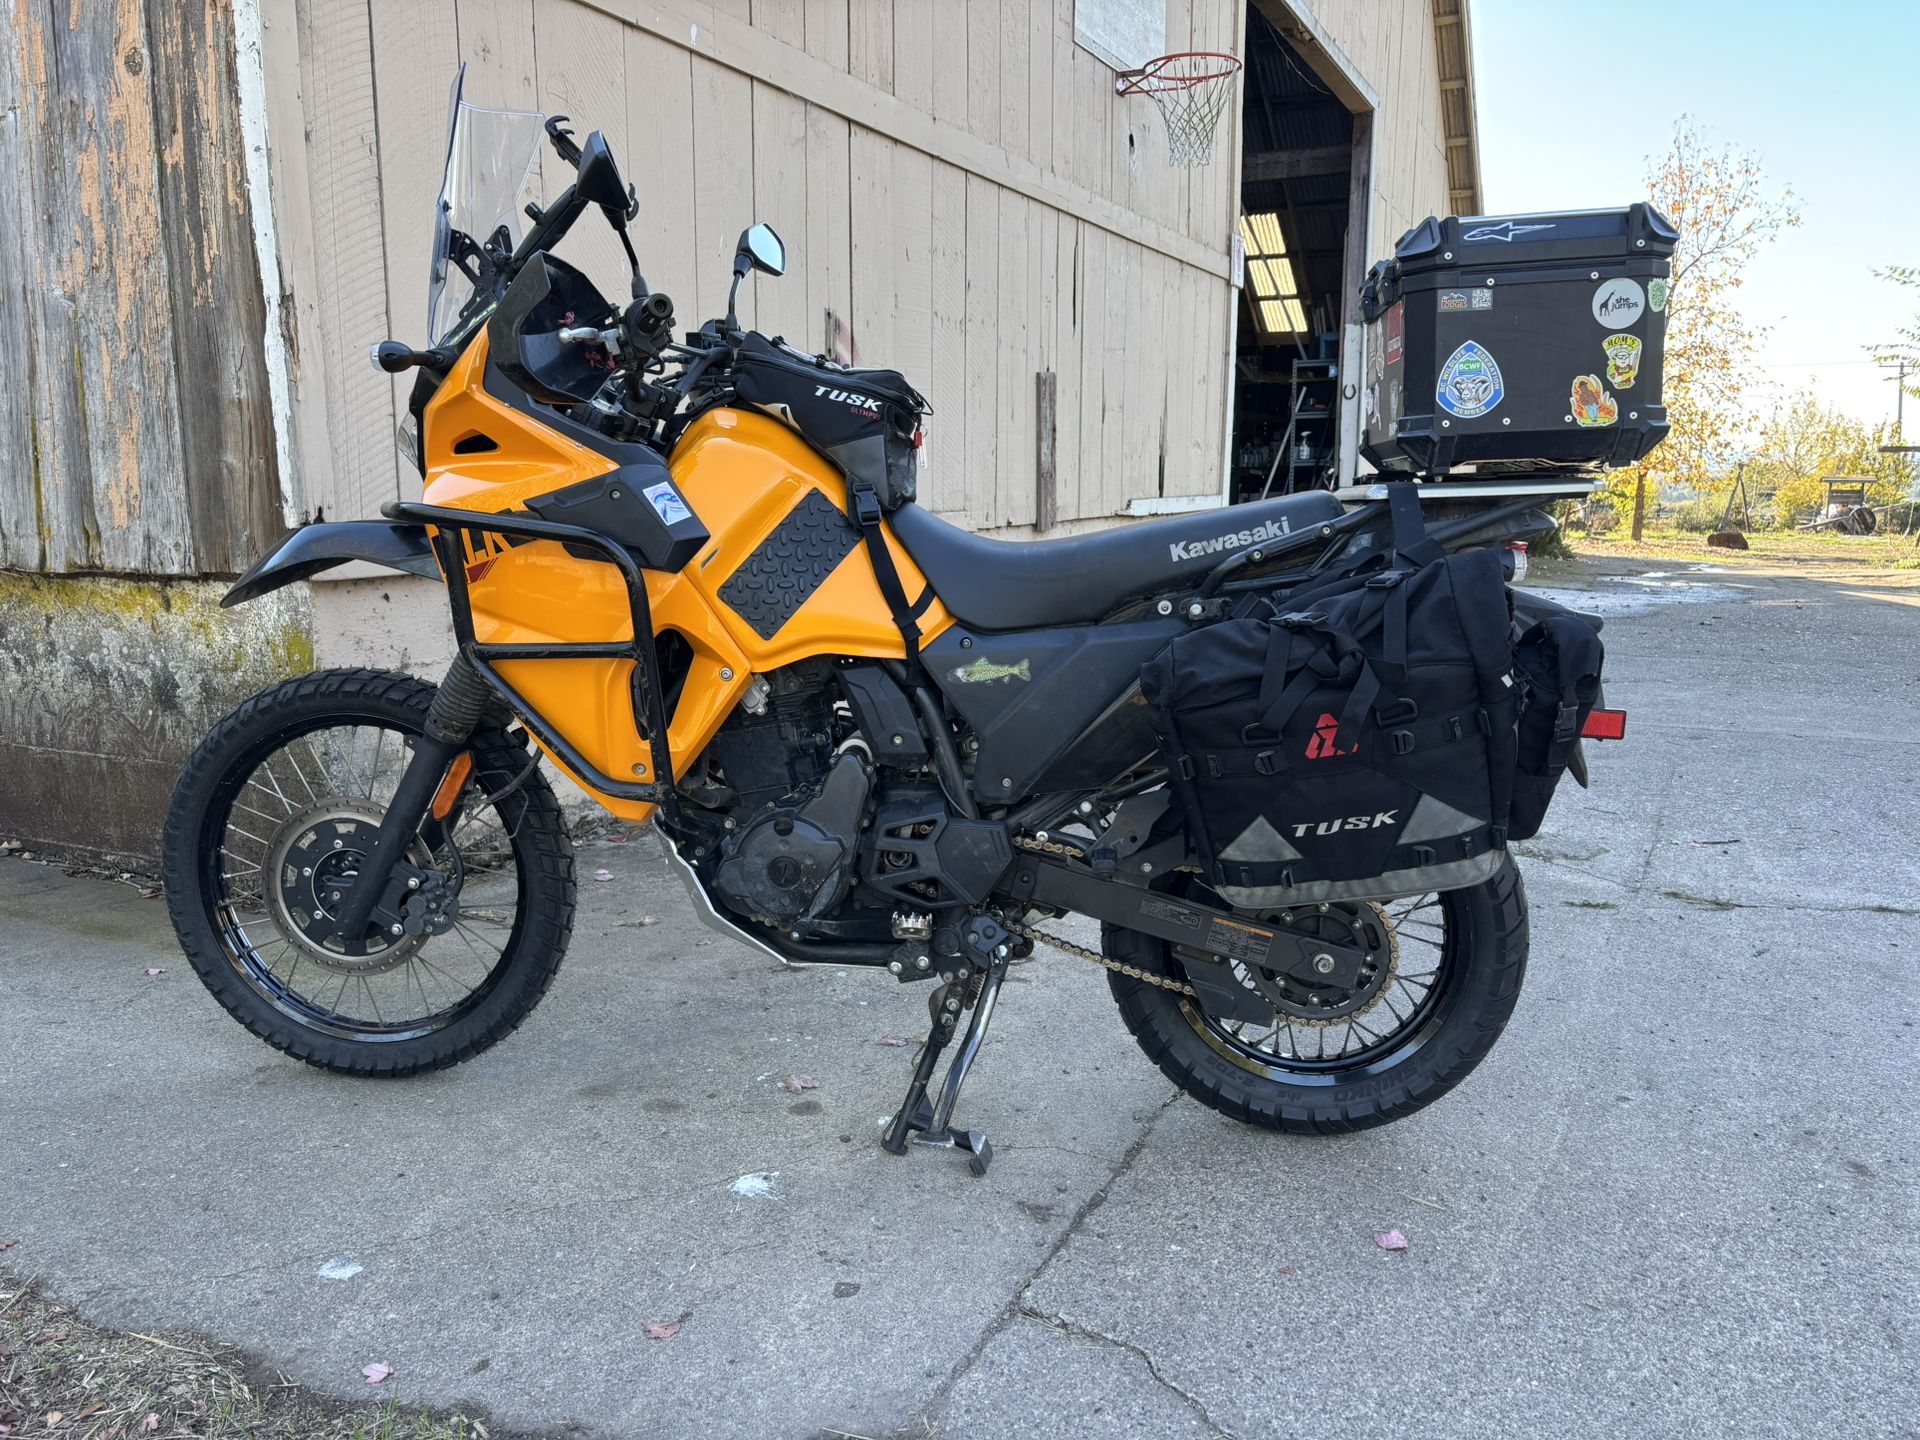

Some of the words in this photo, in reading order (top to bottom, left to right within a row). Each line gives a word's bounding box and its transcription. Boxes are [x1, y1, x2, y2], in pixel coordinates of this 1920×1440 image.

[1611, 301, 1639, 312] jumps
[1615, 296, 1630, 304] she
[1607, 336, 1637, 346] MOM'S
[1442, 348, 1467, 380] WILDLIFE
[1473, 348, 1501, 390] FEDERATION
[814, 385, 883, 412] TUSK
[850, 406, 881, 421] OLYMPUS
[1452, 405, 1487, 415] MEMBER
[1169, 516, 1291, 562] Kawasaki
[1291, 809, 1400, 837] TUSK
